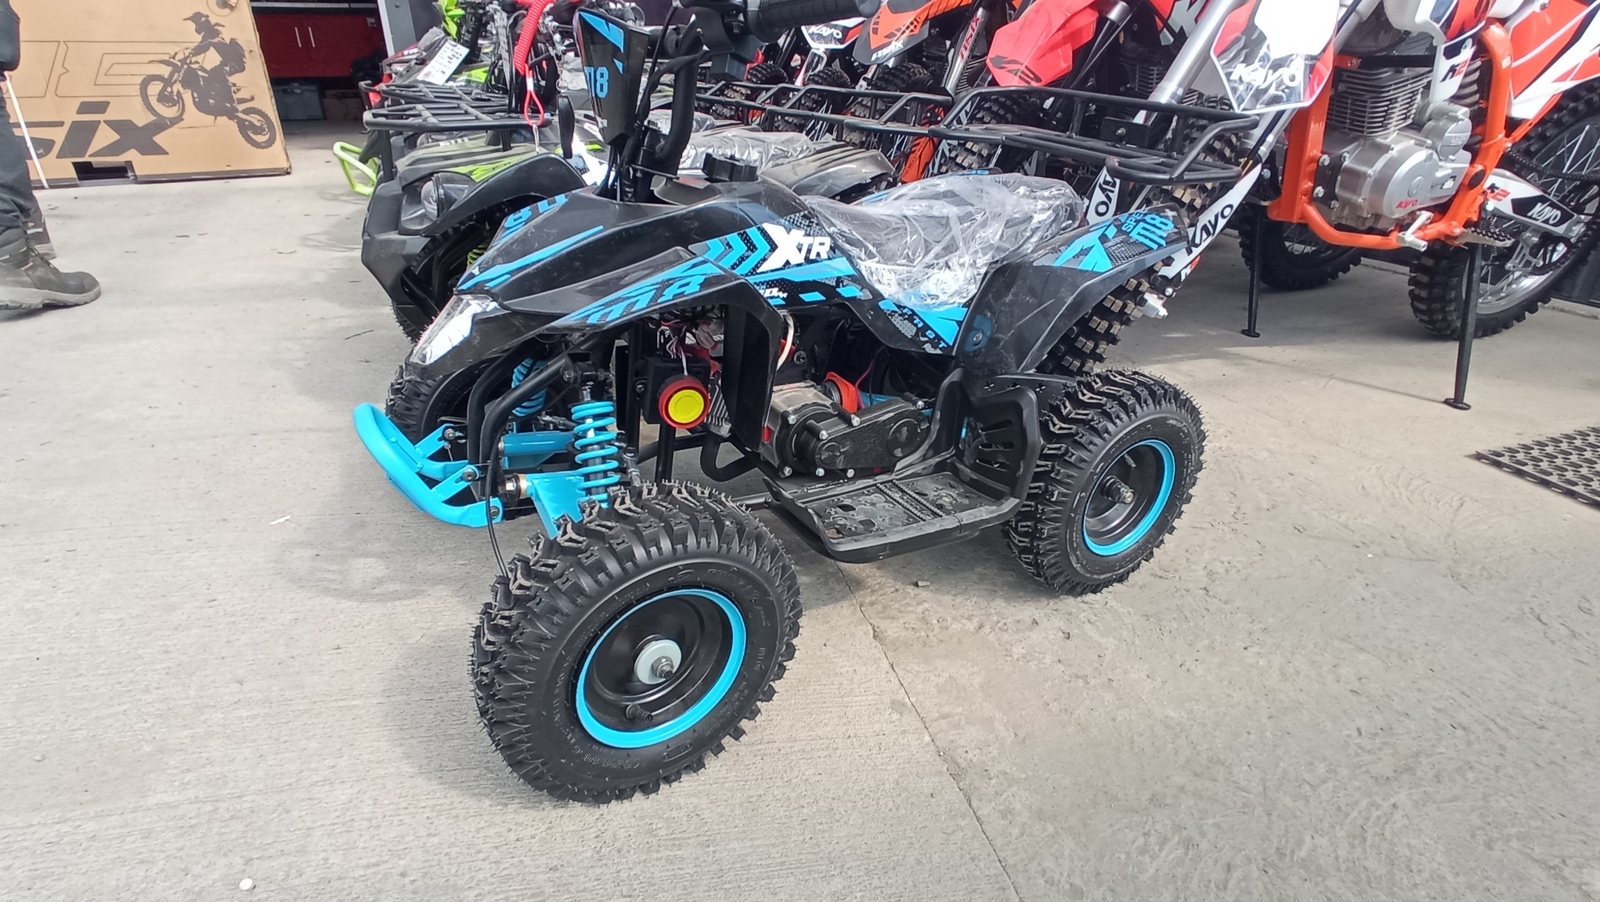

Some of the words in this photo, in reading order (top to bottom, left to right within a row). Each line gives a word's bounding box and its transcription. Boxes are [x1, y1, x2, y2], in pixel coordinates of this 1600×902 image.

[1094, 174, 1117, 217] AYO
[756, 222, 831, 273] XTR
[1183, 203, 1234, 257] KAYO
